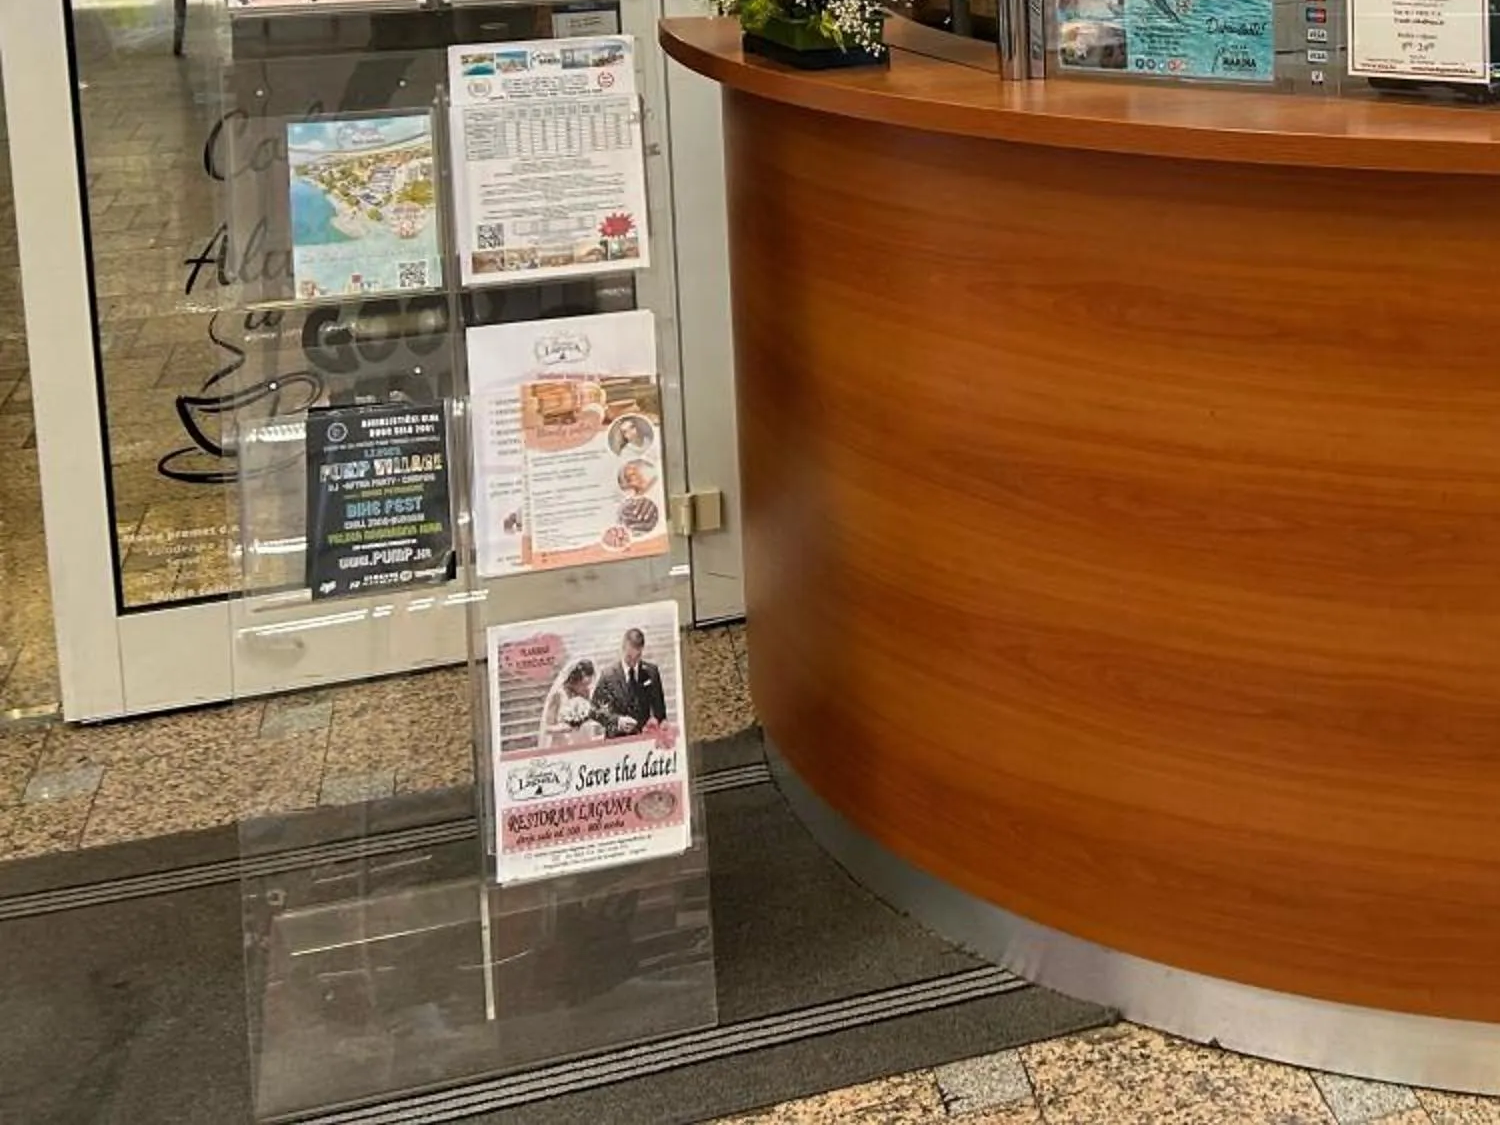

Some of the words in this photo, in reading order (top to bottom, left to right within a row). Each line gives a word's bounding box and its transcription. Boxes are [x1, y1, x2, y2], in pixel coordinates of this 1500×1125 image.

[575, 763, 611, 791] Save
[615, 754, 637, 782] the
[641, 751, 678, 780] date!
[507, 804, 576, 832] RESTORAN
[578, 797, 633, 822] LAGUNA
